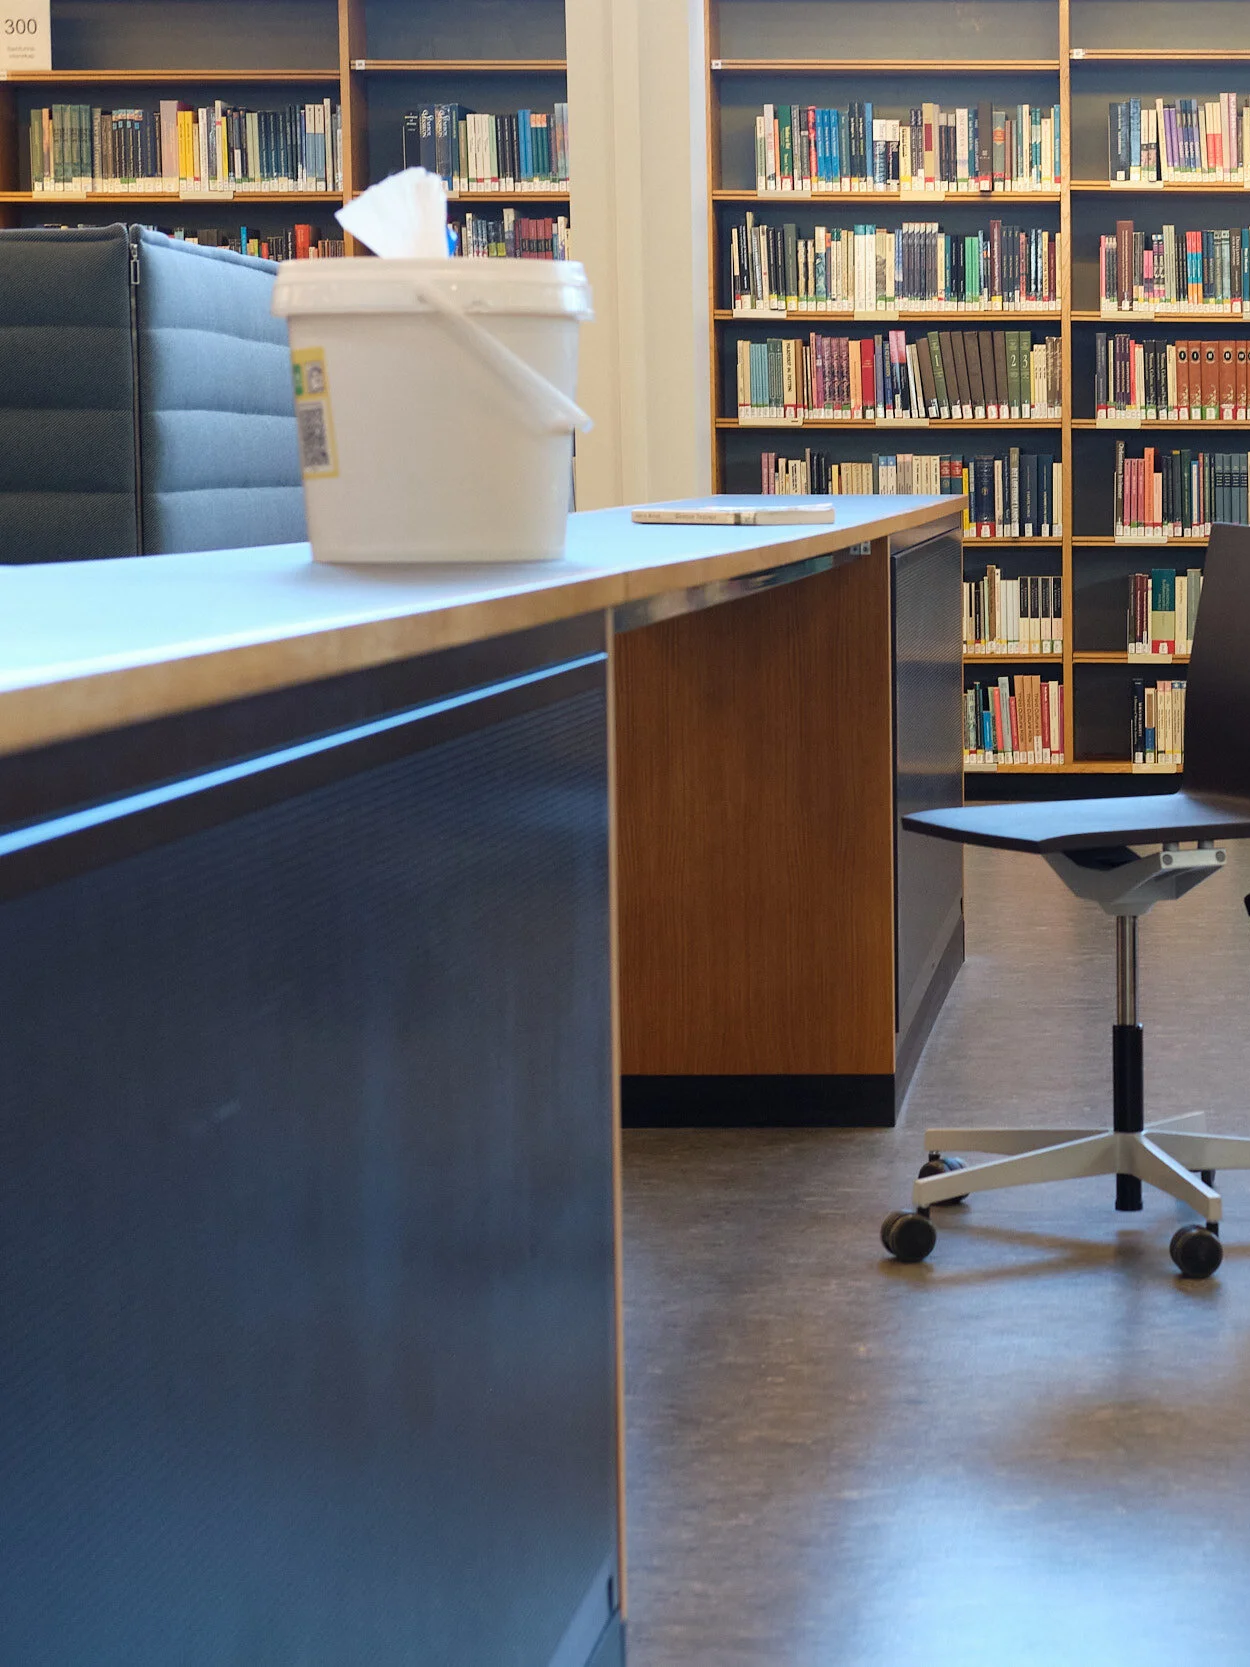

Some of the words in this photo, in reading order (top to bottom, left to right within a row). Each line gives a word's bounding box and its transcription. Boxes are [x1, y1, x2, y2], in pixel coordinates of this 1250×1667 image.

[4, 18, 37, 34] 300
[935, 355, 940, 366] 1
[1010, 355, 1017, 367] 2
[1022, 354, 1029, 368] 3
